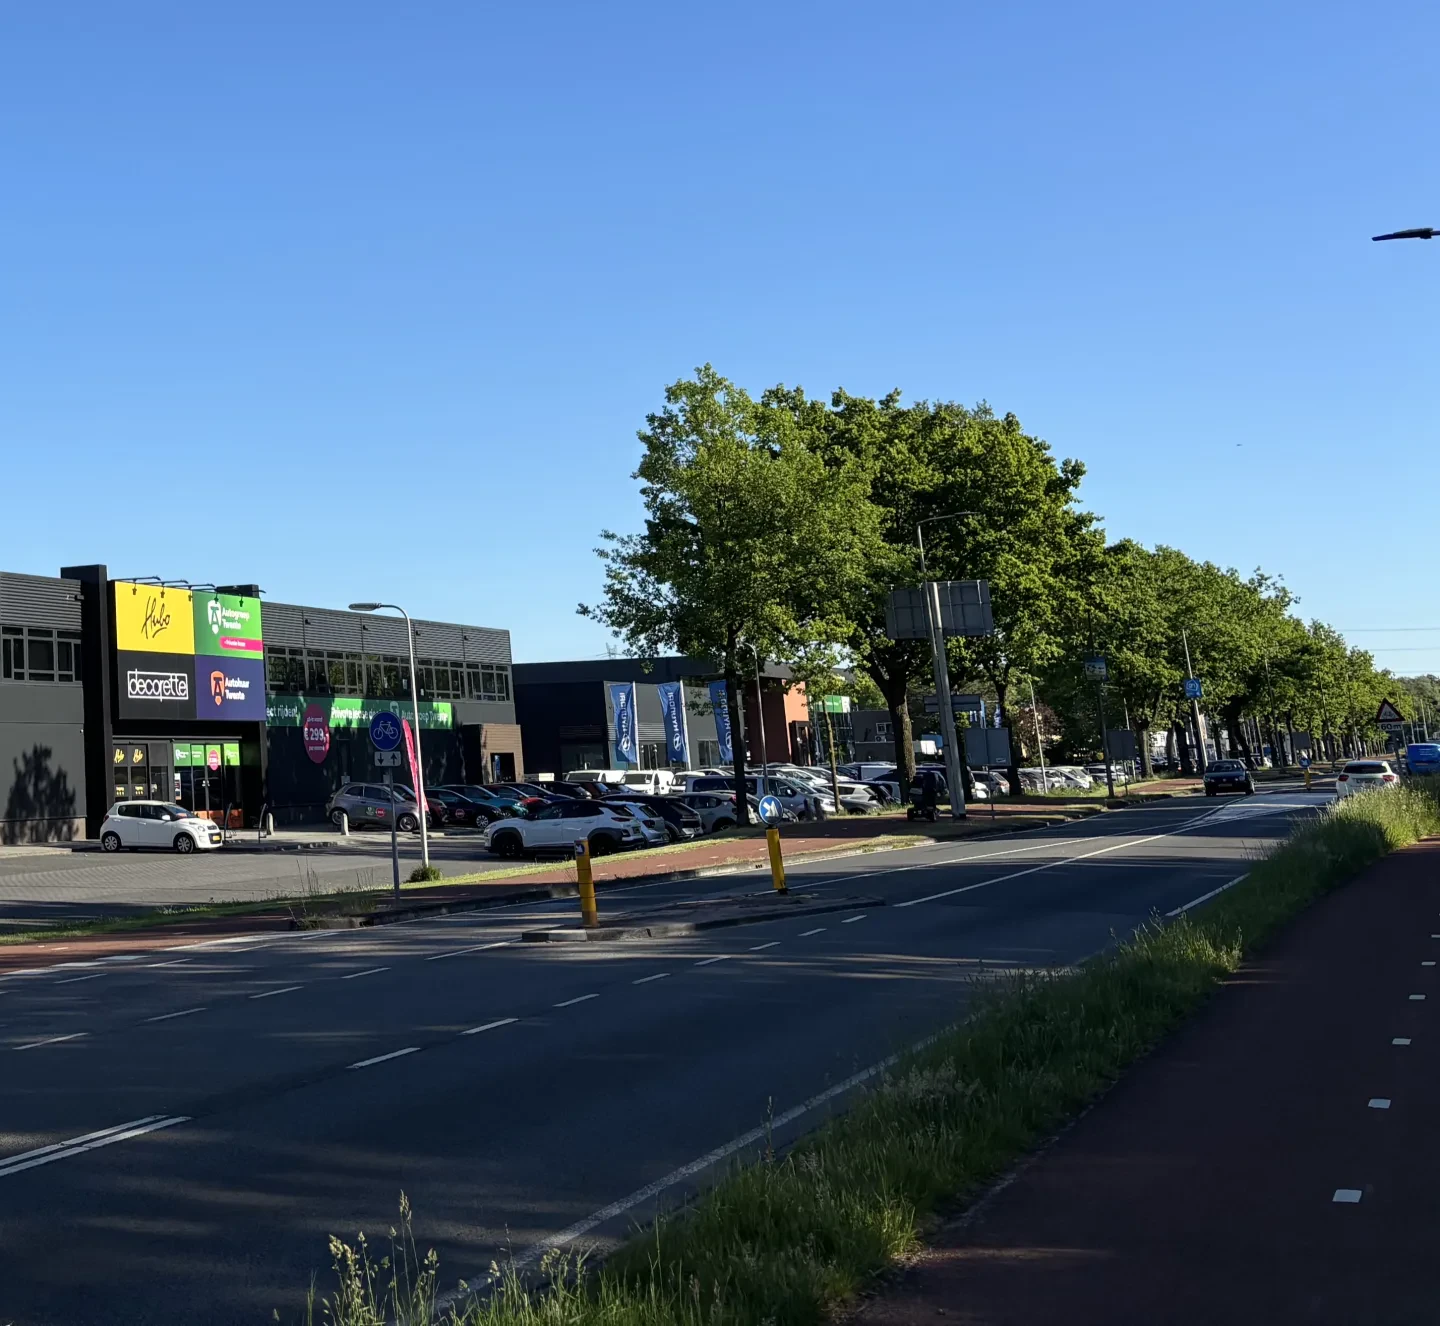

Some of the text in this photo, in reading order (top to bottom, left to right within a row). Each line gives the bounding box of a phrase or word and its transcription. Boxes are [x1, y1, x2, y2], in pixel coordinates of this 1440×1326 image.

[141, 595, 170, 639] Hubo
[222, 607, 250, 622] Autogroep
[222, 618, 242, 630] Twente
[129, 668, 187, 702] decorette
[224, 689, 246, 701] Twente
[331, 706, 352, 719] Private
[304, 727, 309, 741] €
